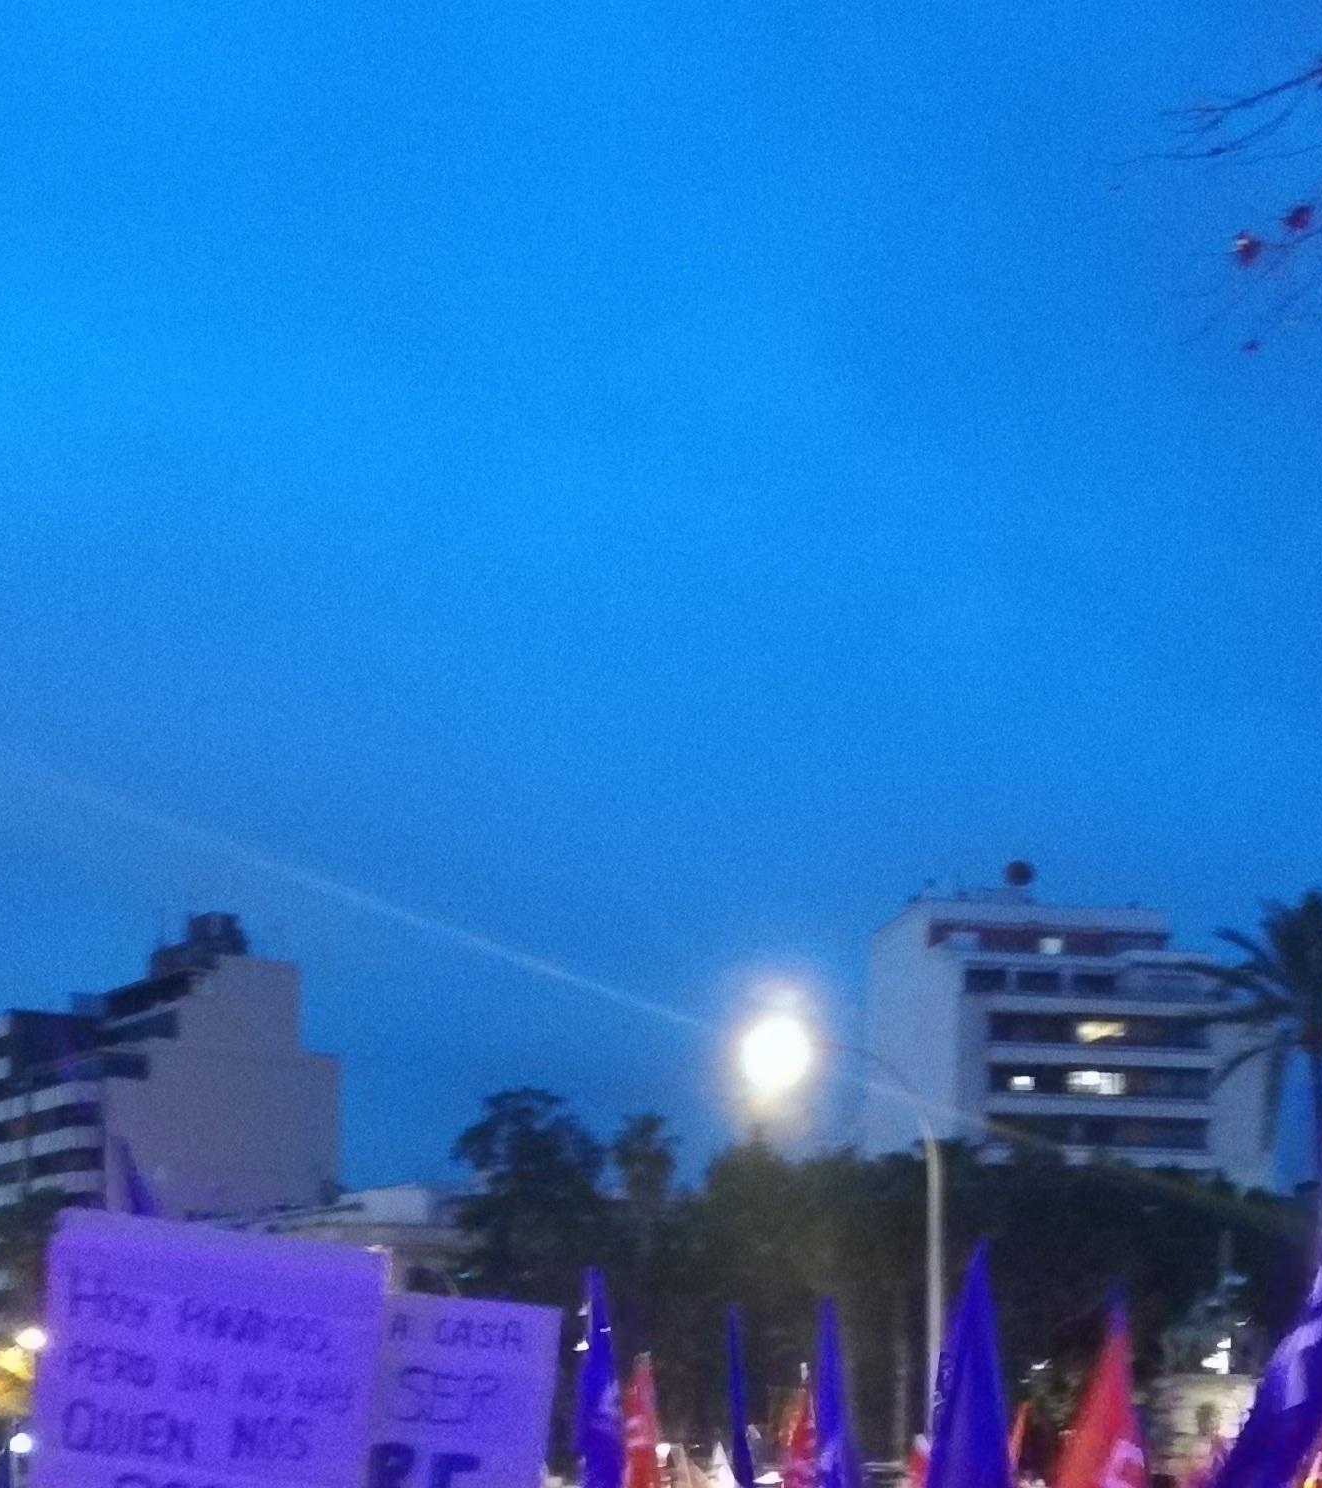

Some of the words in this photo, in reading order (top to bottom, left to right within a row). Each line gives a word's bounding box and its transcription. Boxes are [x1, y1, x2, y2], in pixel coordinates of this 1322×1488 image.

[434, 1317, 525, 1353] CASA
[67, 1342, 158, 1390] PERO
[395, 1366, 501, 1425] SER
[62, 1399, 194, 1461] QUIEN
[230, 1413, 312, 1462] NOS
